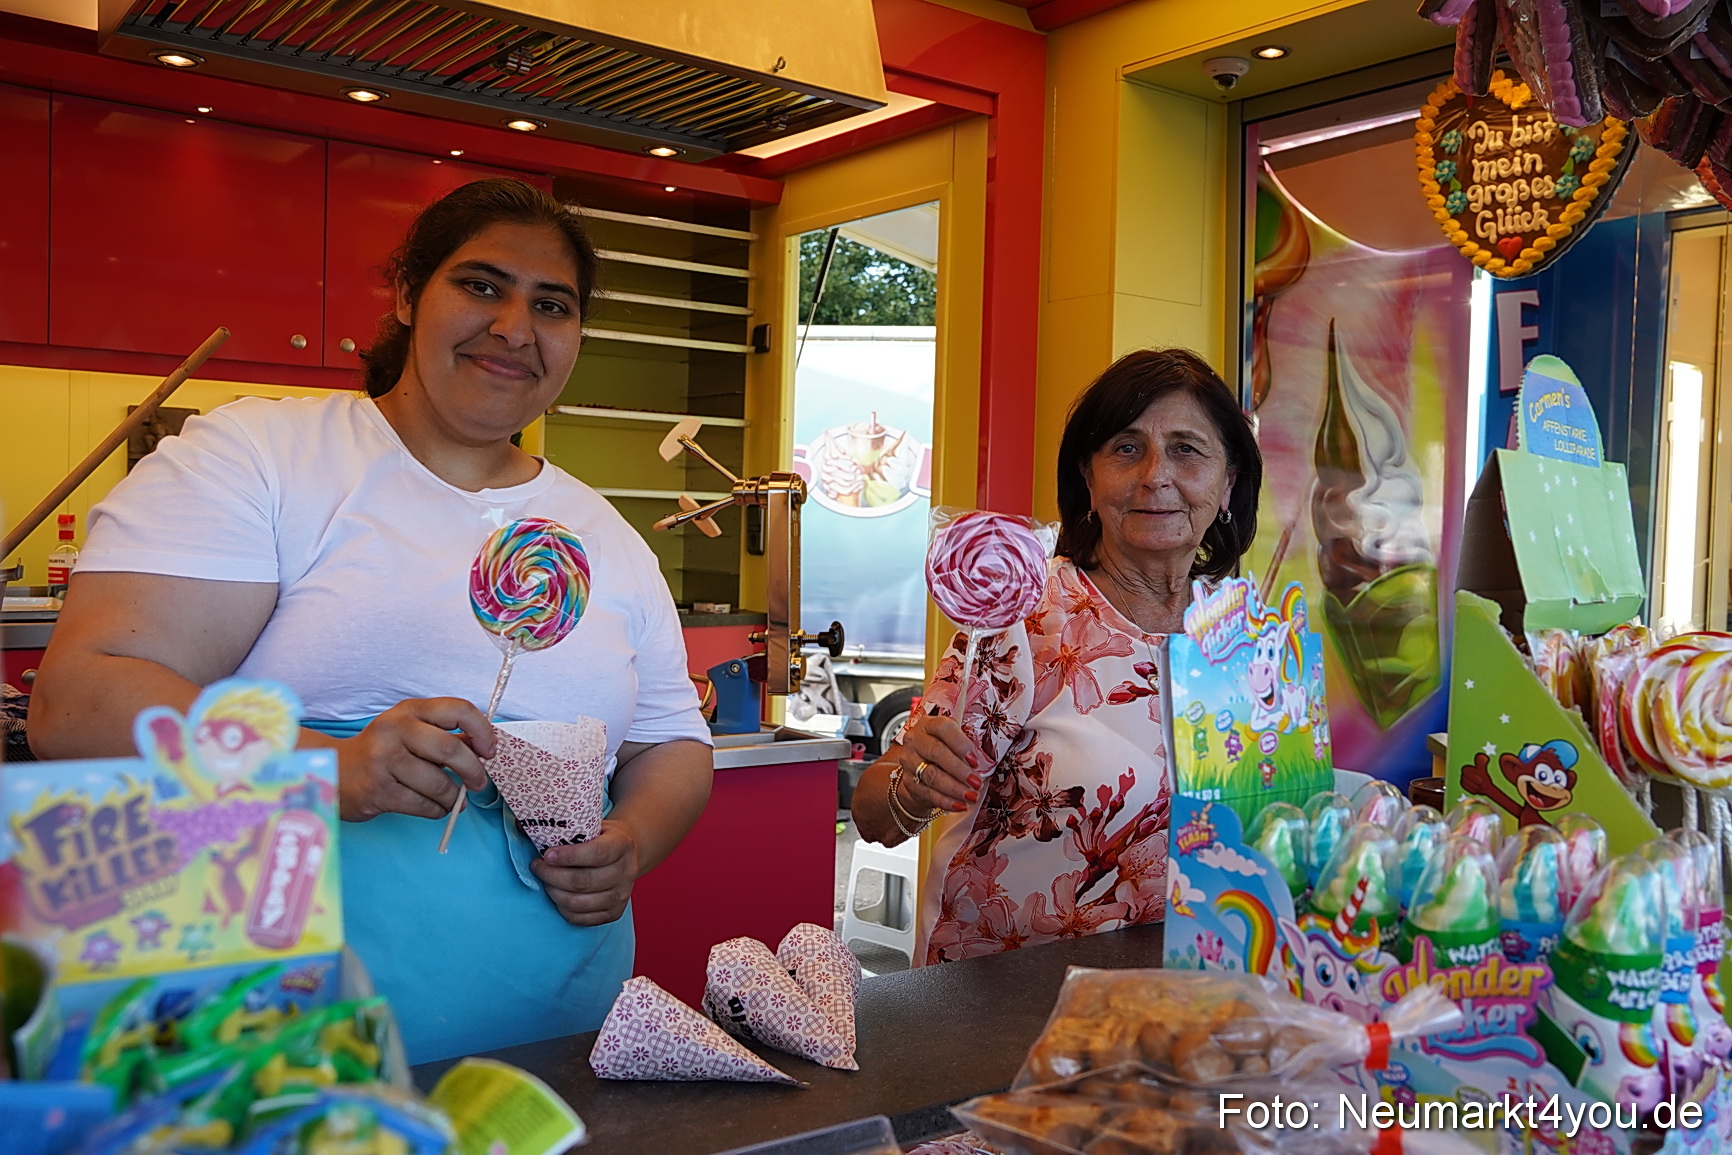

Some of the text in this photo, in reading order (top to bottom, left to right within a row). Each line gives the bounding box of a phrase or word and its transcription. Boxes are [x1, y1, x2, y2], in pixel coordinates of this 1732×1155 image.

[1468, 112, 1558, 154] Du bist
[1472, 150, 1544, 183] mein
[1466, 175, 1556, 213] großes
[1475, 201, 1551, 244] Glück
[1529, 387, 1571, 423] Carmen's
[1187, 584, 1247, 640] Wonder
